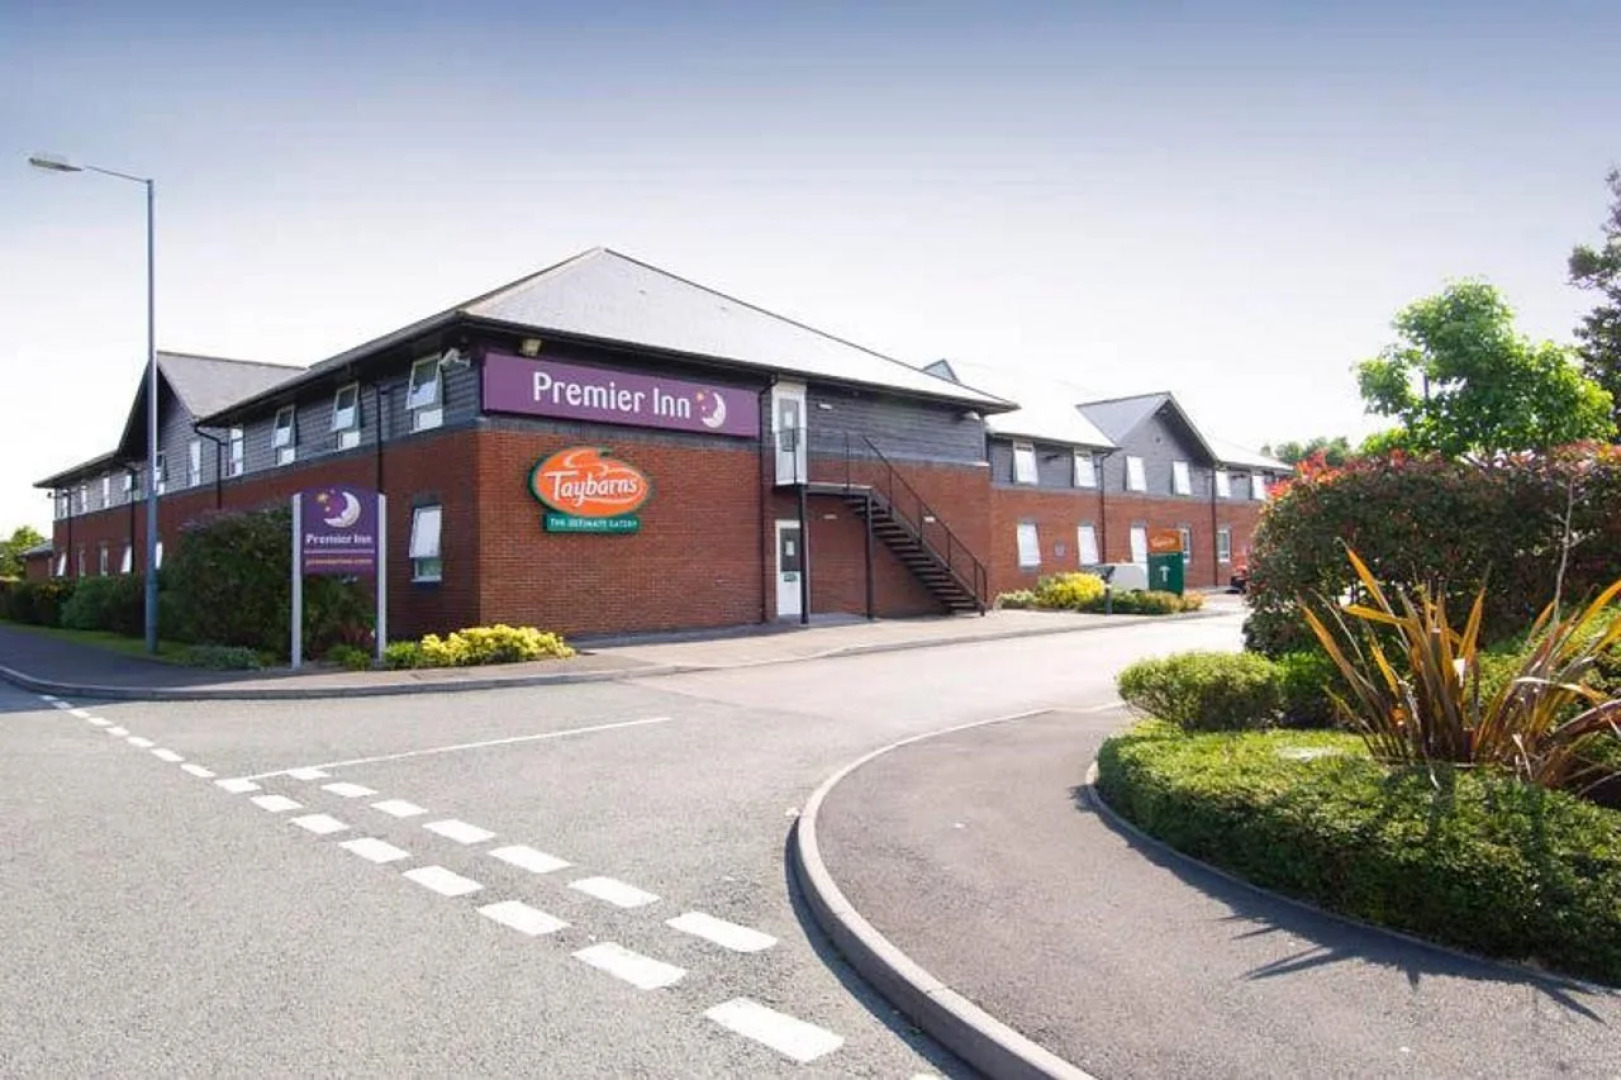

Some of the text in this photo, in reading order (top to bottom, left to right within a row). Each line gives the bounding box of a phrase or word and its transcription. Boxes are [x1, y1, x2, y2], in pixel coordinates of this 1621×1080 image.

[534, 372, 691, 418] Premier Inn
[544, 470, 638, 507] Taybarns
[306, 534, 372, 543] Premier Inn
